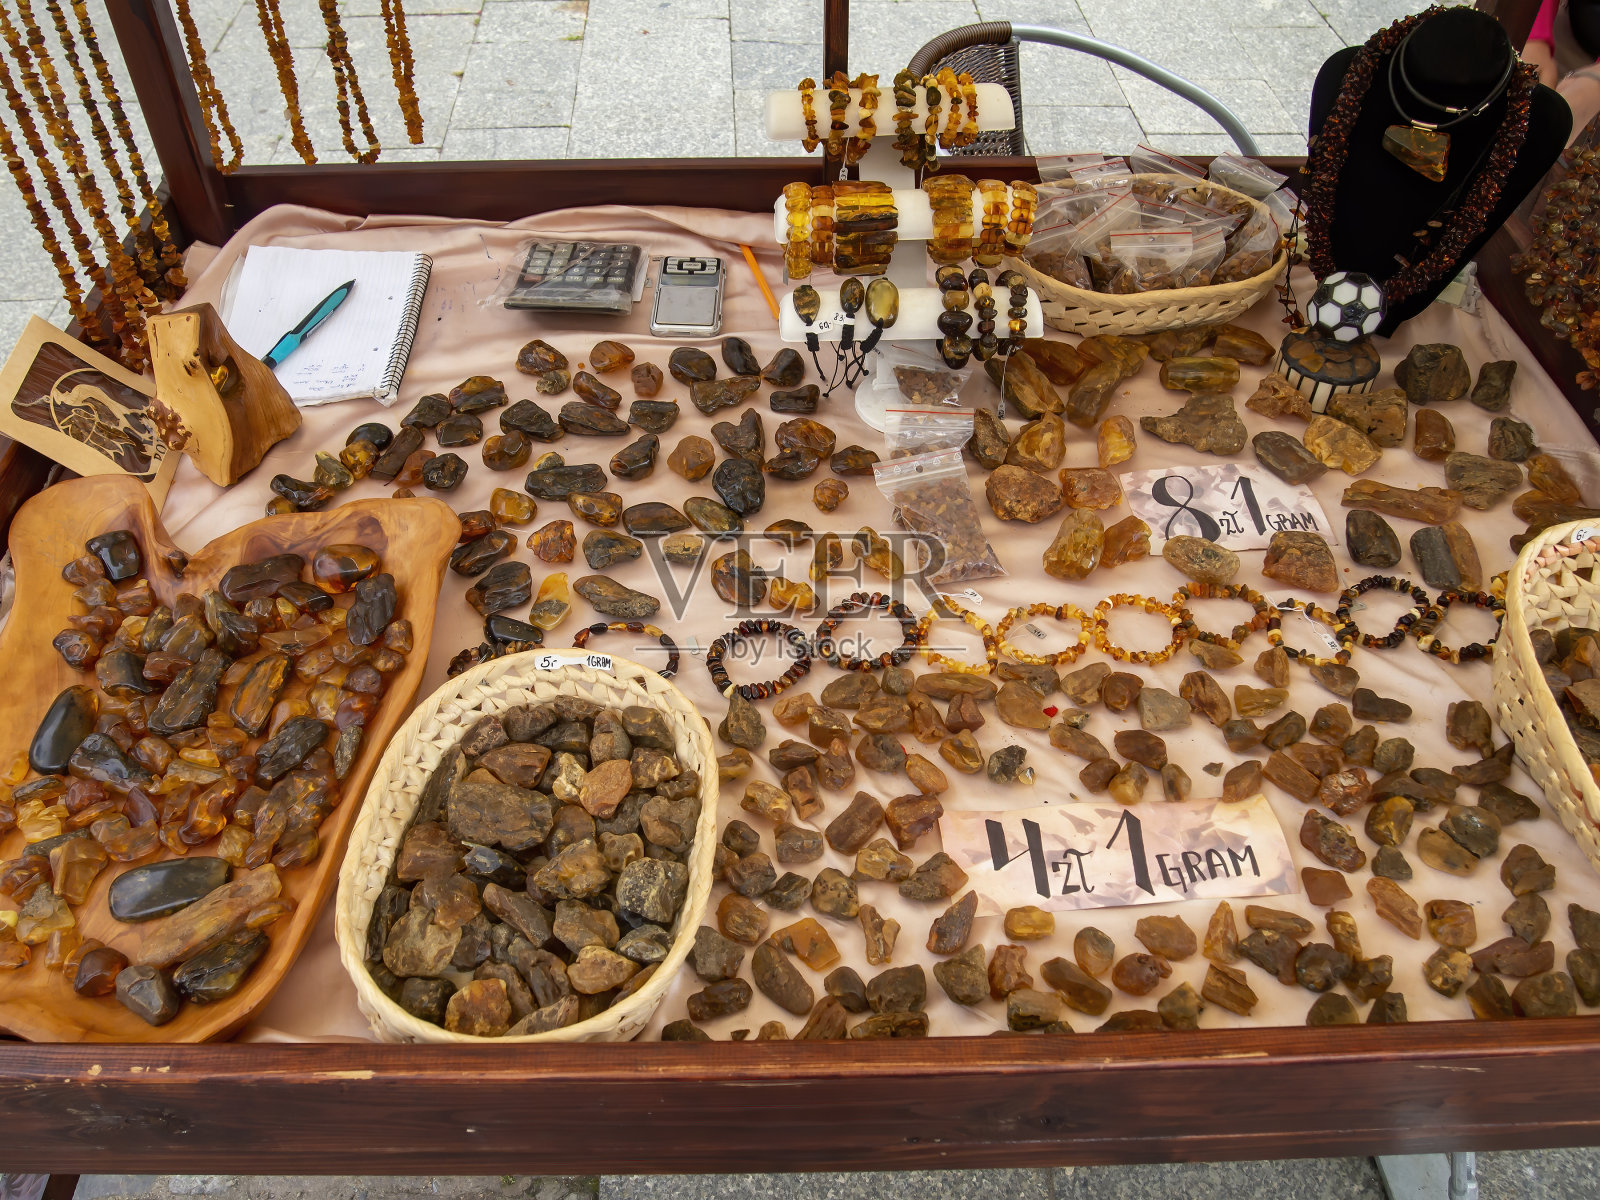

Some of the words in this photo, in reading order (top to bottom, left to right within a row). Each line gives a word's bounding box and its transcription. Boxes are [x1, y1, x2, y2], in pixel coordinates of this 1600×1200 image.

[1152, 475, 1221, 543] 8
[1231, 476, 1267, 536] 1
[985, 818, 1051, 899] 4
[1106, 809, 1156, 897] 1
[1156, 845, 1261, 894] GRAM
